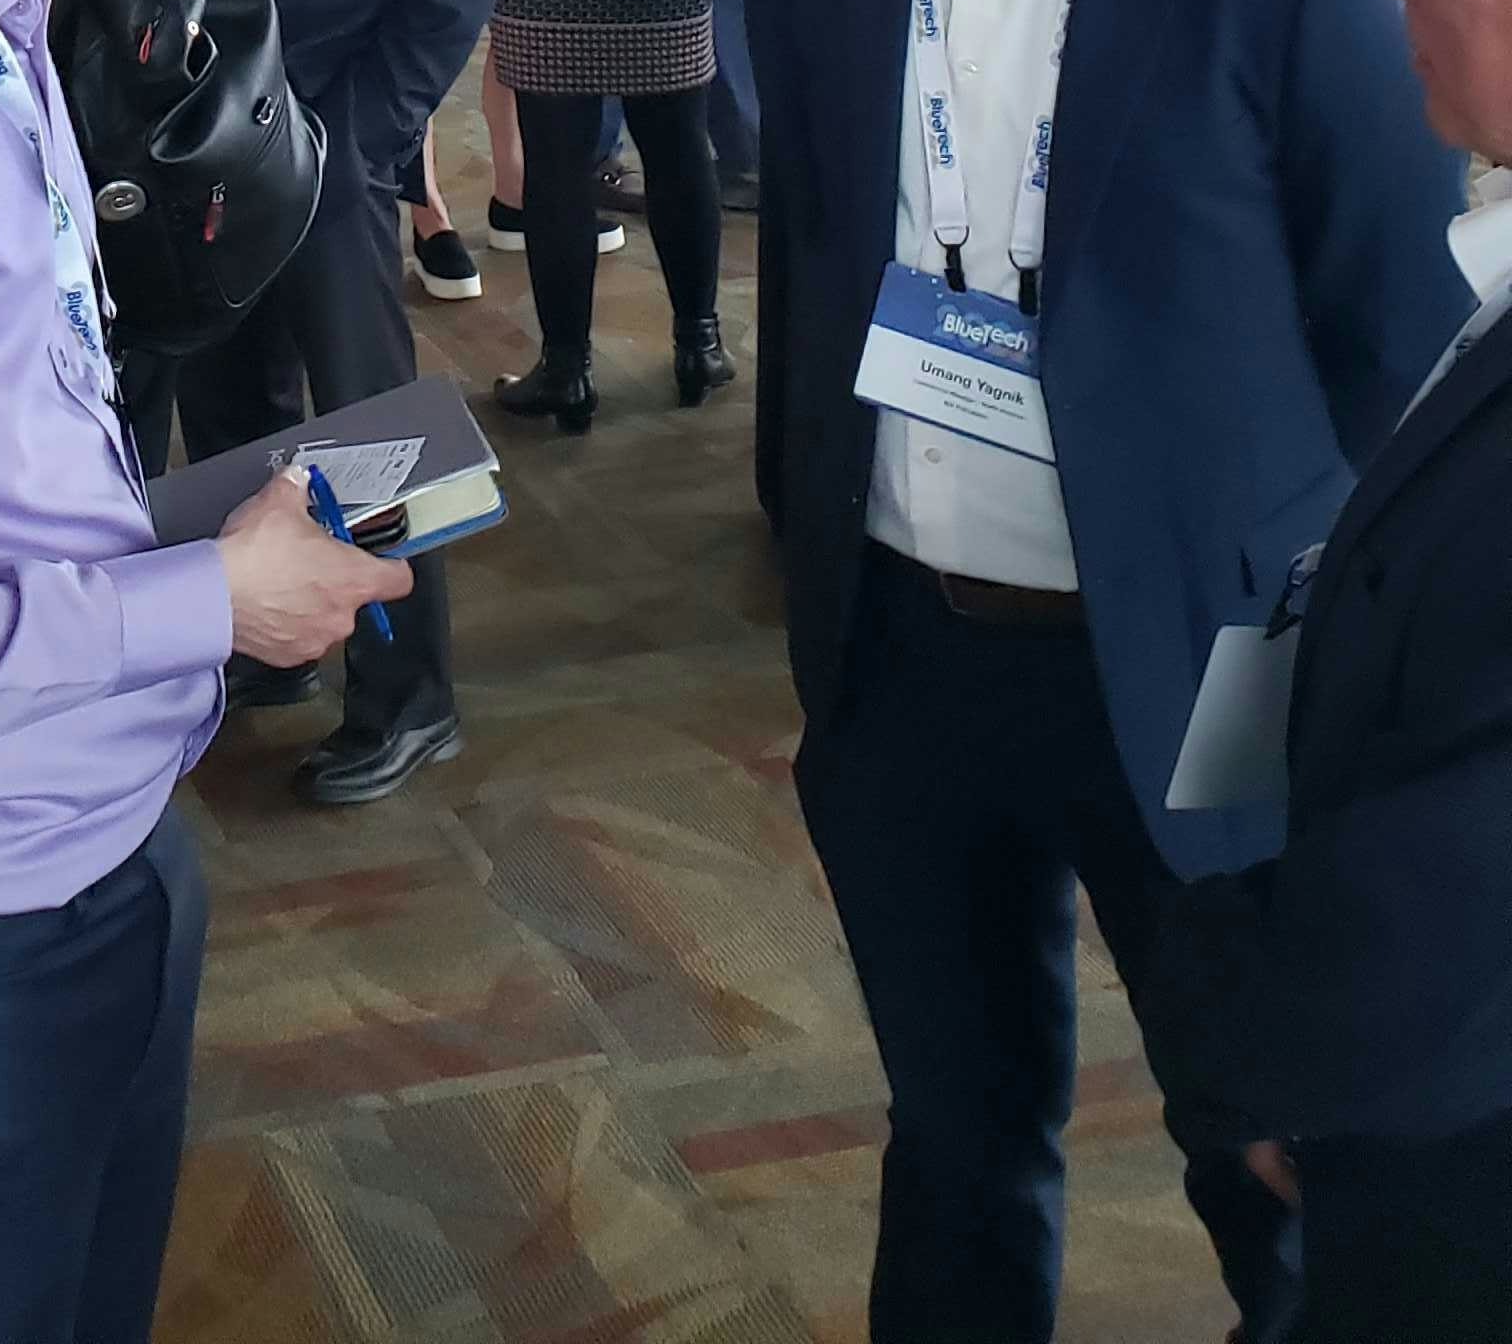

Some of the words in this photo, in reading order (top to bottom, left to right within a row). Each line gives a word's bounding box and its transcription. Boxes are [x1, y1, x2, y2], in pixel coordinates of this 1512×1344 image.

[929, 97, 953, 165] BlueTech
[942, 312, 1030, 353] BlueTech
[920, 359, 973, 389] Umang
[976, 377, 1025, 406] Yagnik
